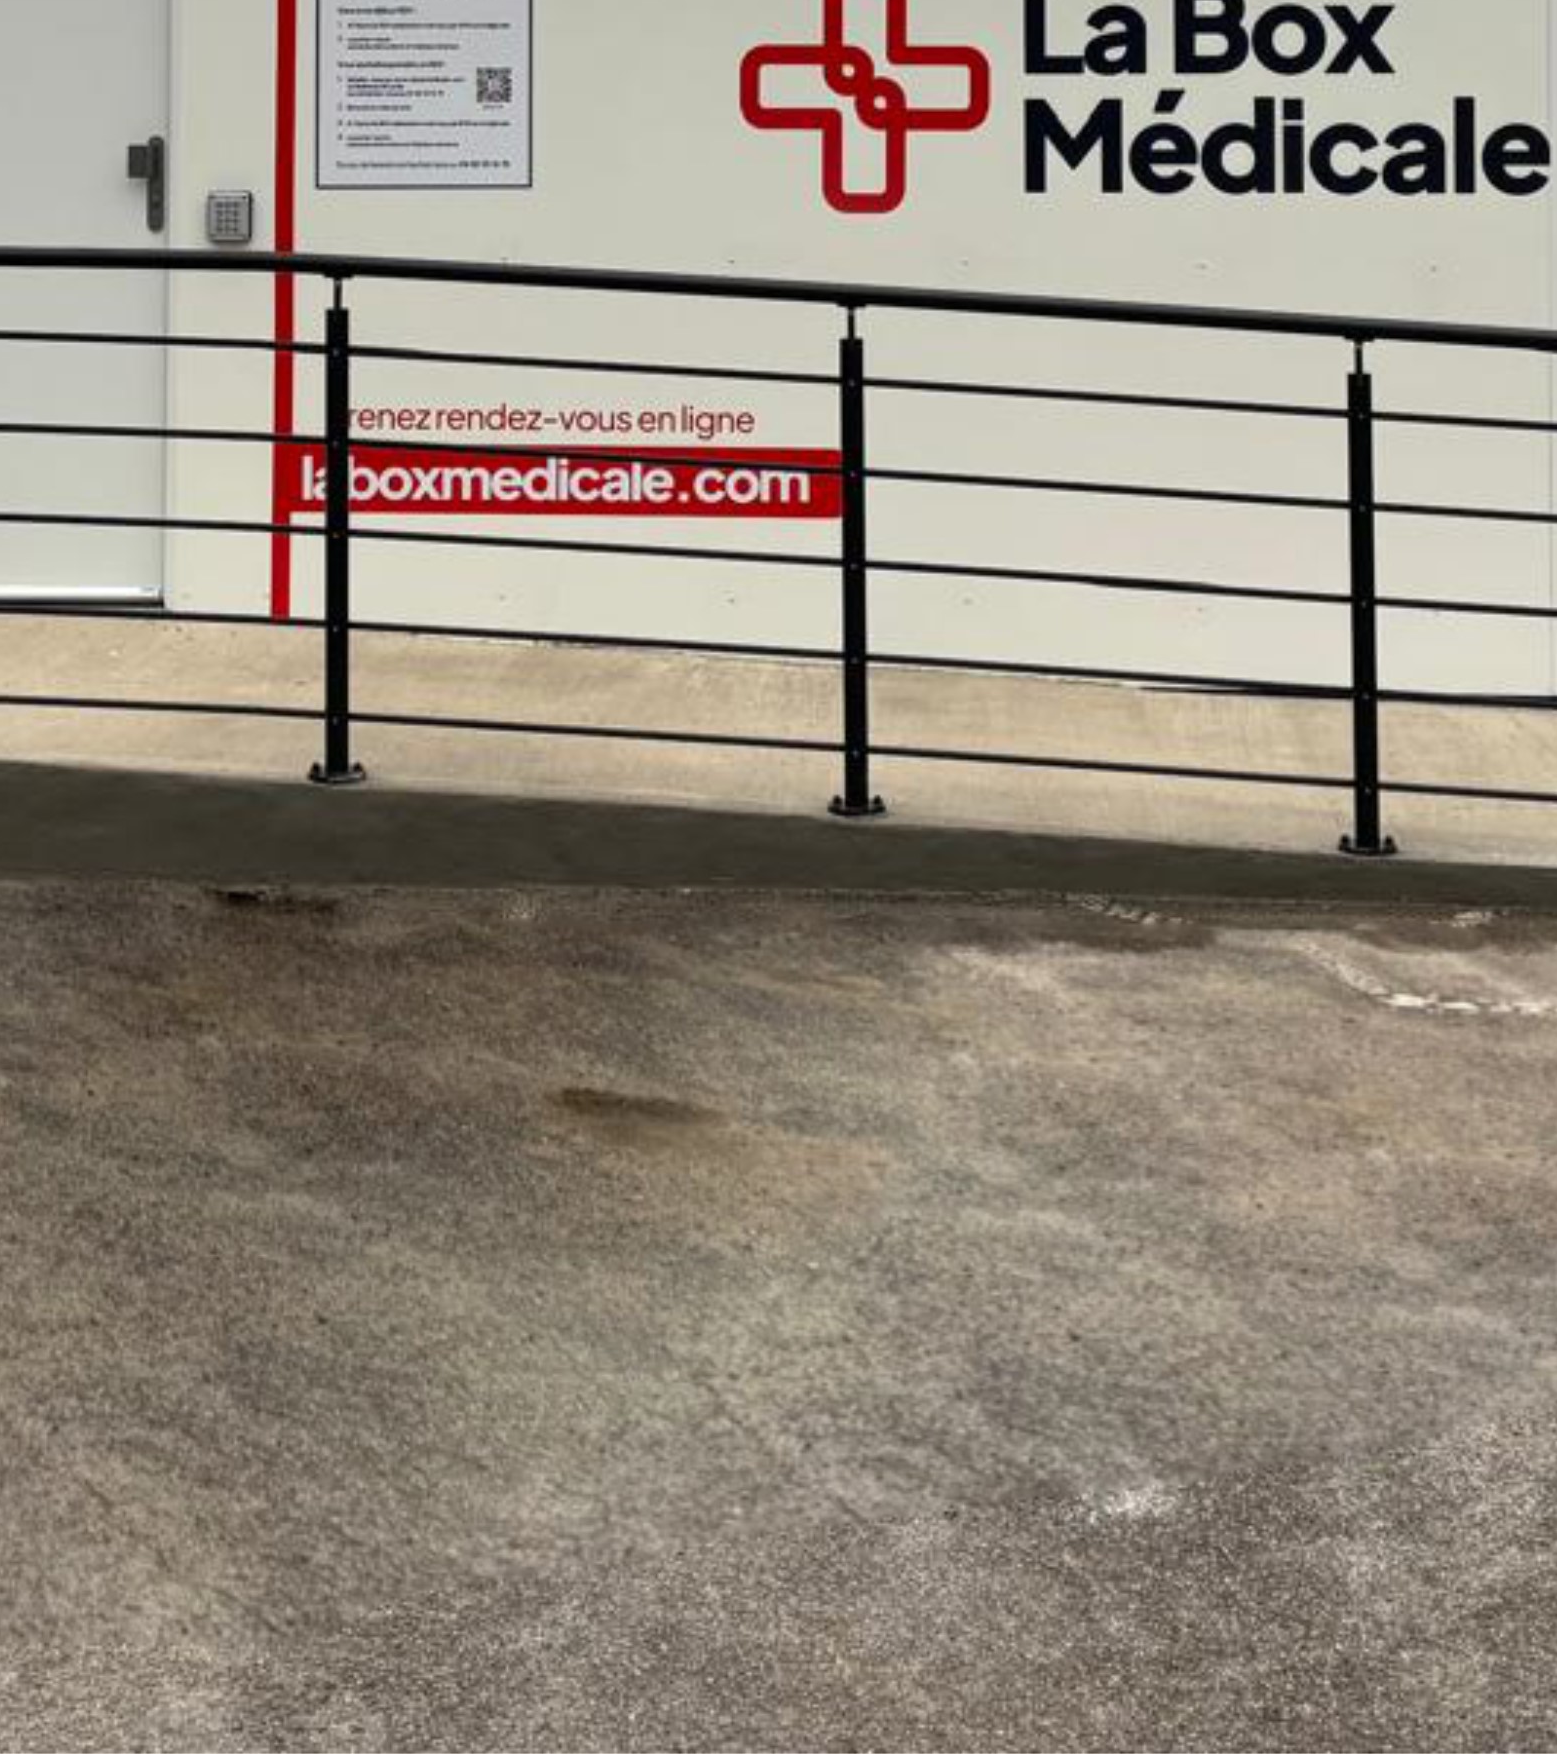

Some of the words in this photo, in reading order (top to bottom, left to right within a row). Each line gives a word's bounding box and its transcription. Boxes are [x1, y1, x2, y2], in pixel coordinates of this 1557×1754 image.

[1023, 89, 1552, 196] Médicale
[348, 407, 431, 431] renez
[435, 403, 632, 433] rendez-vous
[637, 410, 677, 434] en
[680, 404, 756, 440] ligne
